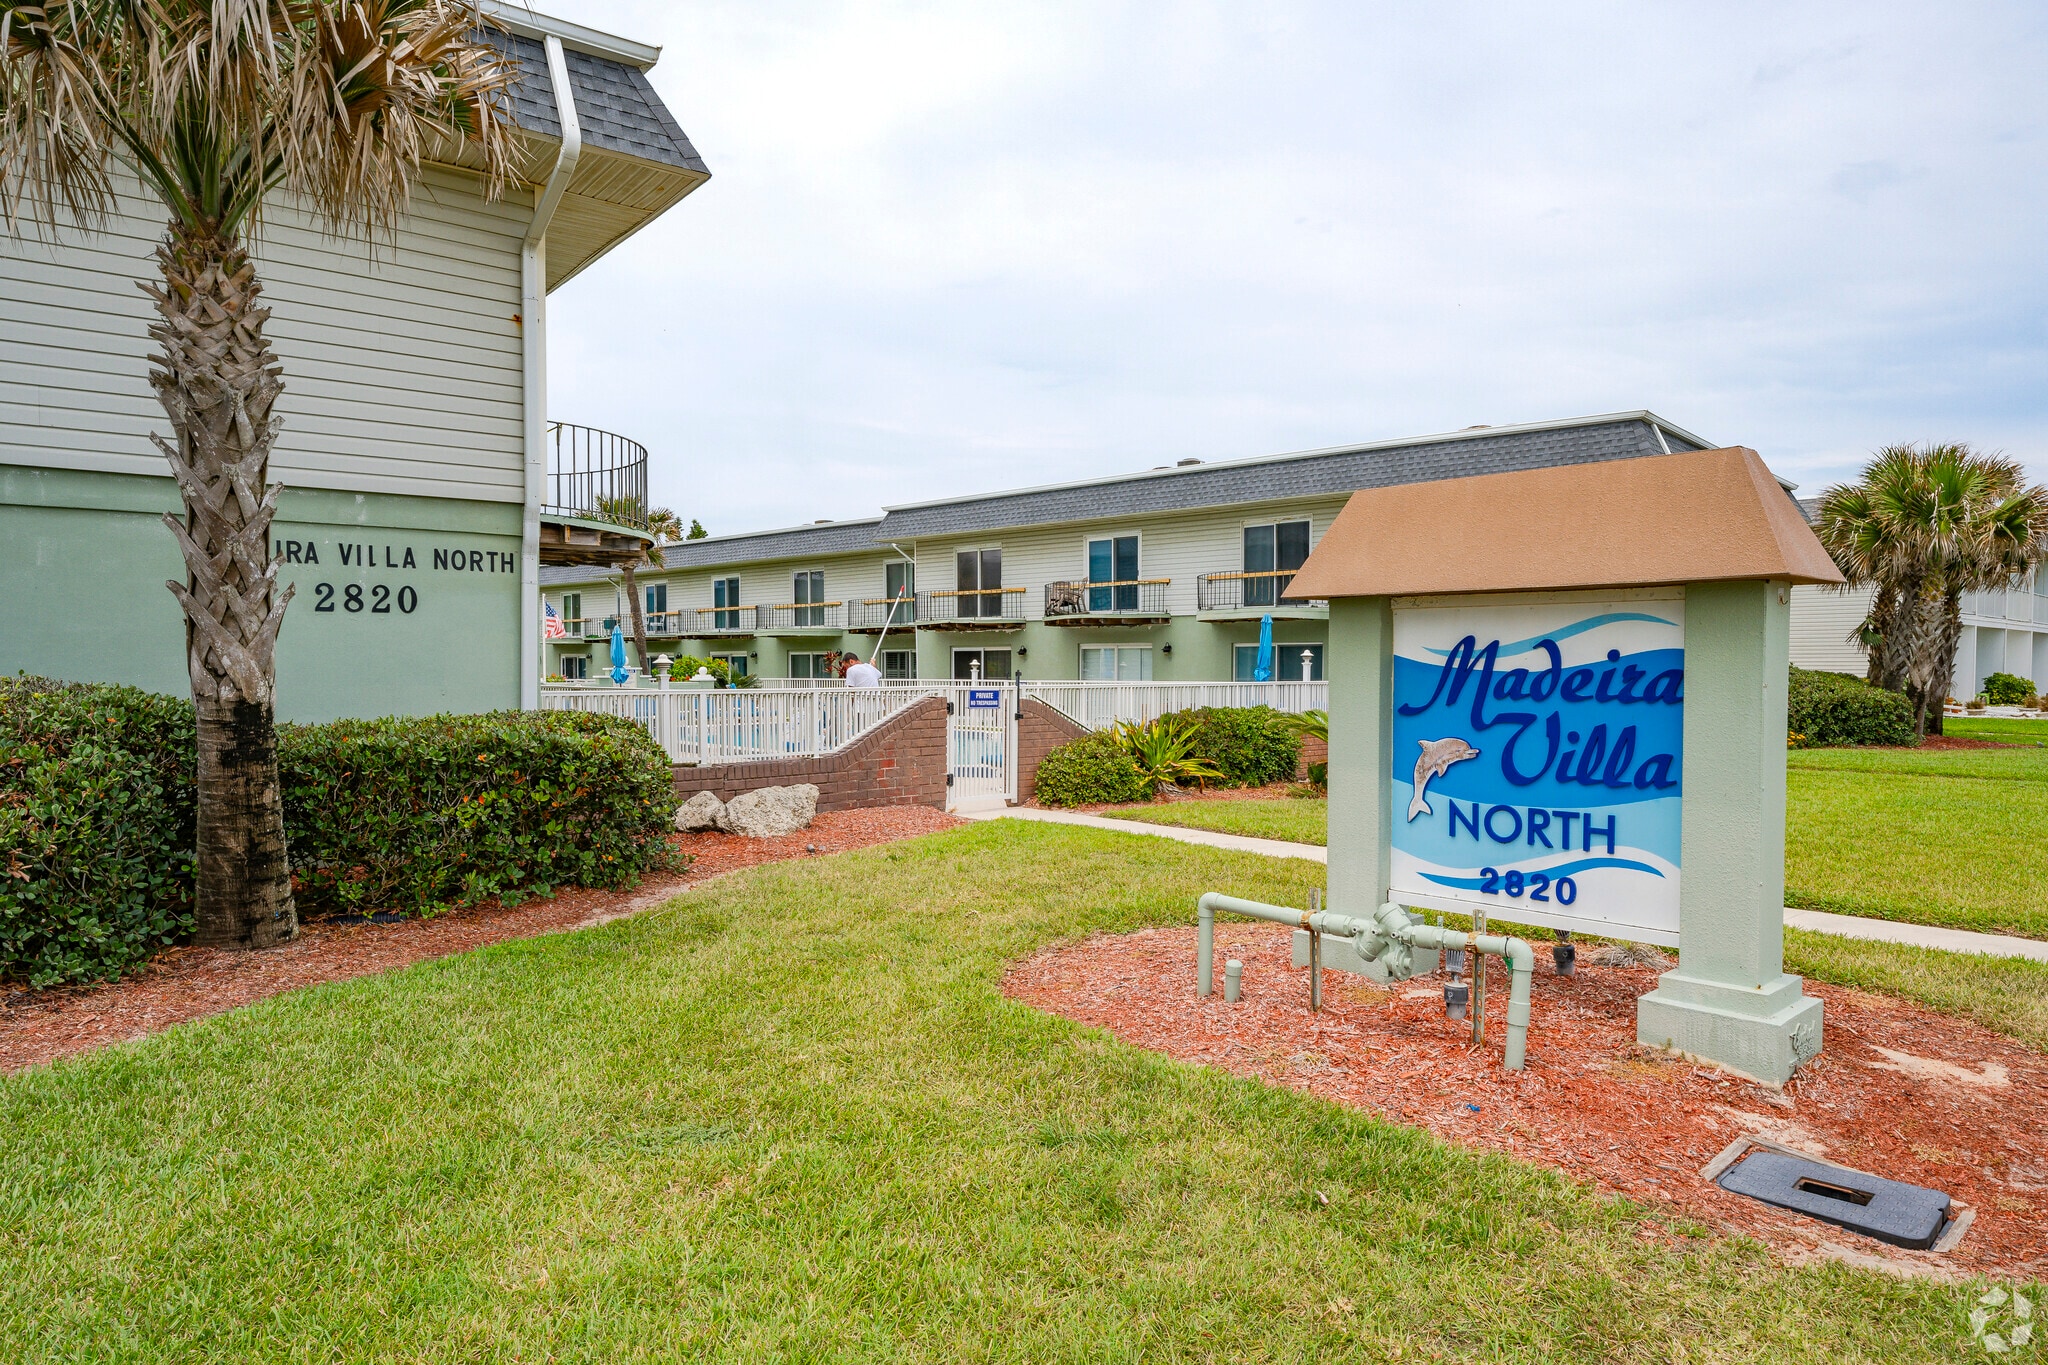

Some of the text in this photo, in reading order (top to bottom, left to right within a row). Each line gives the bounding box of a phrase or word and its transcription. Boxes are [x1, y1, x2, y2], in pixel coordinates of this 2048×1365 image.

[338, 543, 416, 569] VILLA
[433, 548, 514, 573] NORTH
[314, 582, 418, 614] 2820
[1398, 634, 1685, 731] Madeira
[1492, 711, 1679, 791] Villa
[1449, 798, 1616, 855] NORTH
[1479, 866, 1578, 906] 2820
